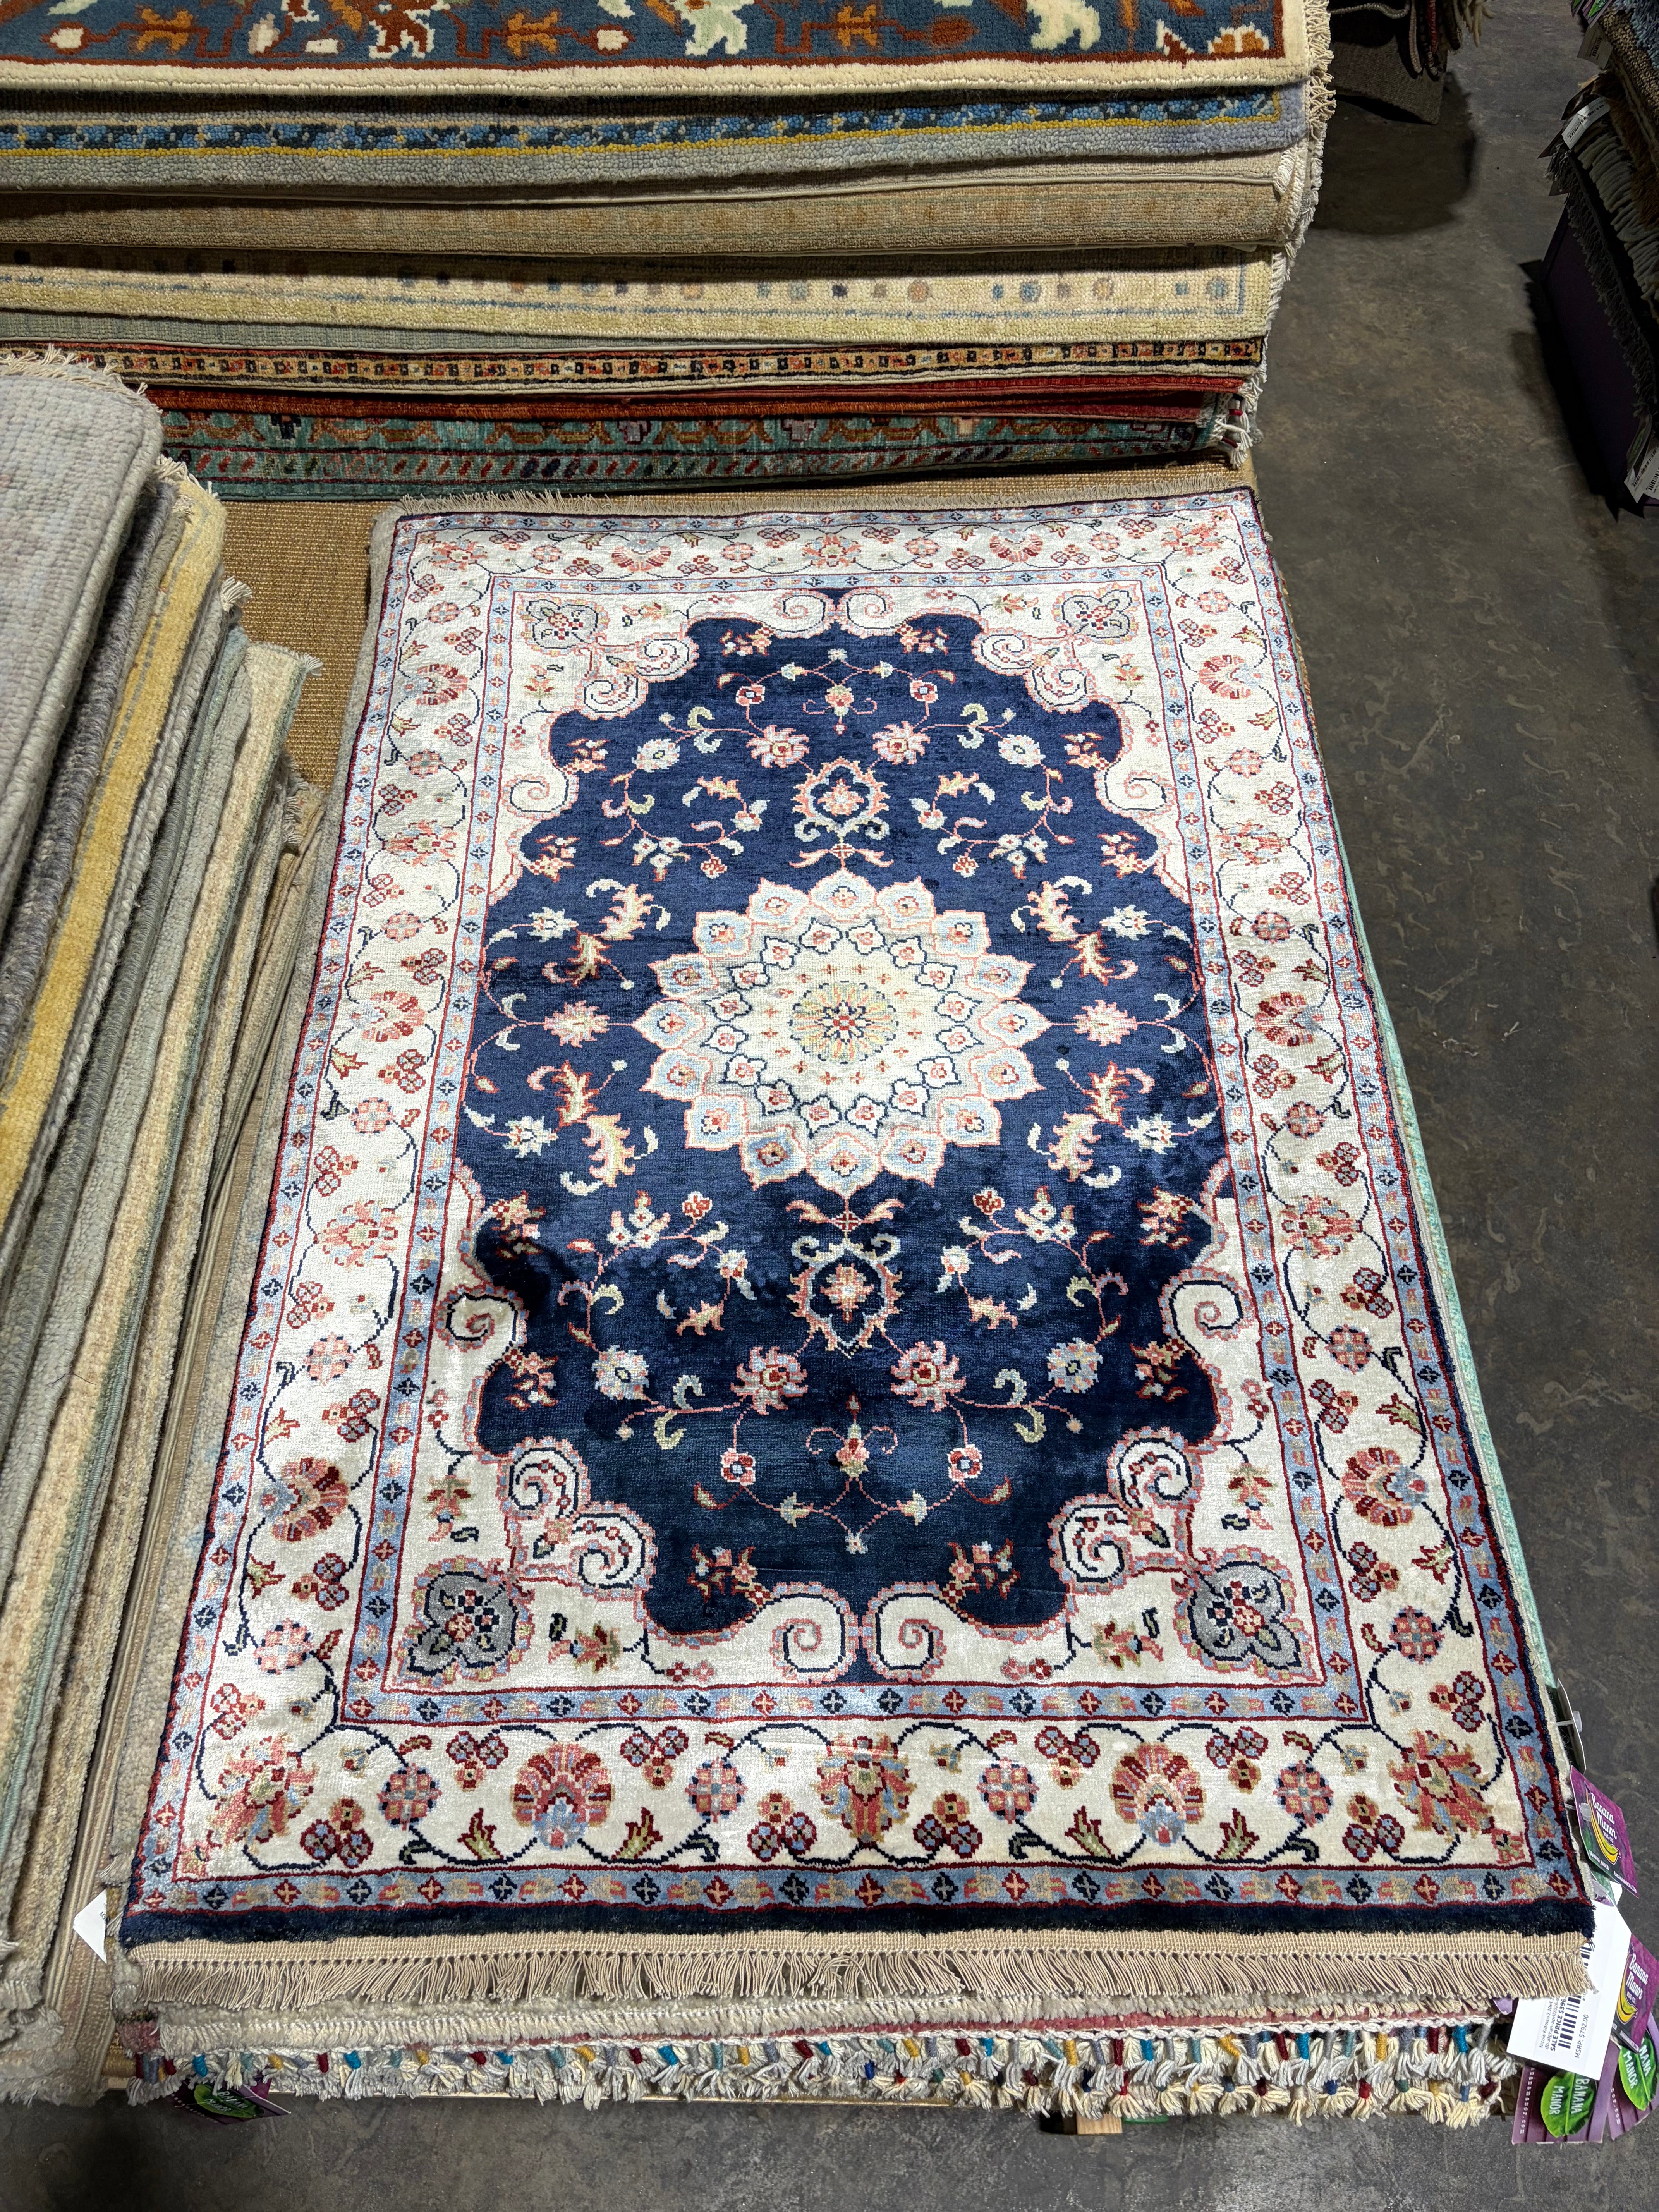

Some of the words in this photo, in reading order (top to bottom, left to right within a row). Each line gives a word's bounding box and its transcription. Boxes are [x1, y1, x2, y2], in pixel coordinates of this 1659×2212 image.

[1591, 1792, 1615, 1825] Banana
[1596, 1810, 1617, 1840] Manor
[1629, 1953, 1649, 1985] Banana
[1625, 1971, 1643, 2000] Manor
[1554, 2015, 1563, 2034] PRICE
[1575, 2039, 1583, 2058] MSRP:
[1579, 2014, 1589, 2038] $792.00
[1623, 2050, 1638, 2090] MANOR
[1549, 2085, 1565, 2115] MANOR
[1571, 2078, 1590, 2114] BANANA
